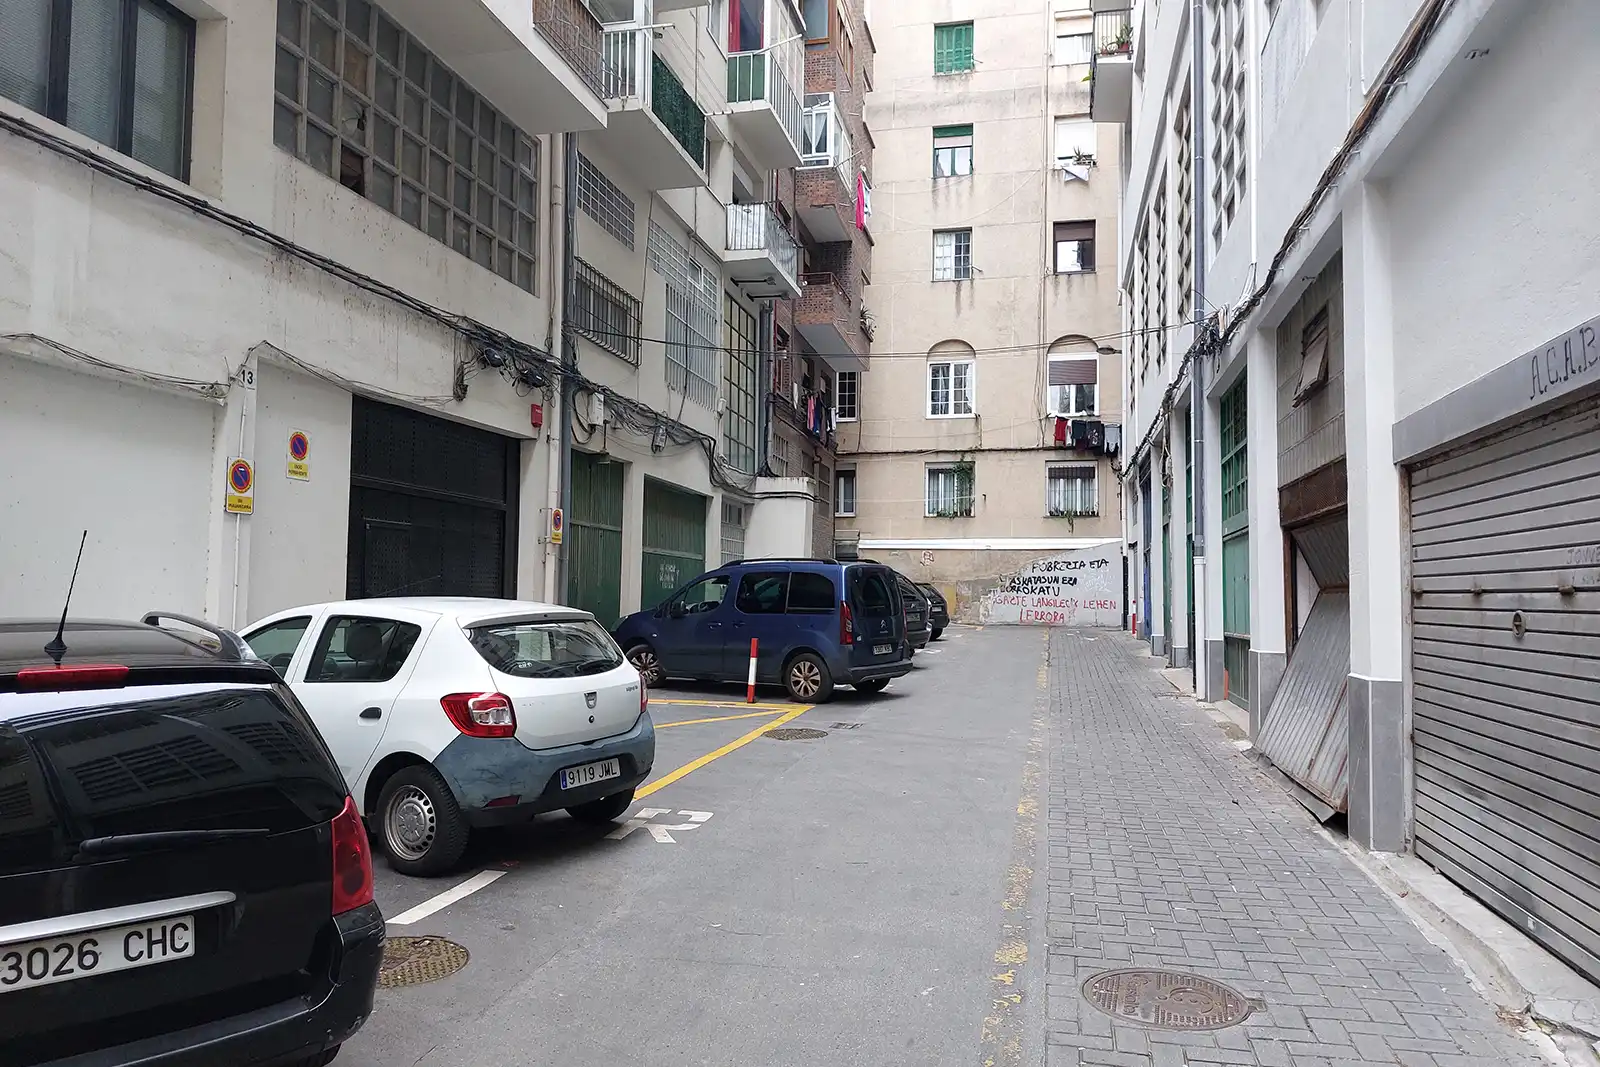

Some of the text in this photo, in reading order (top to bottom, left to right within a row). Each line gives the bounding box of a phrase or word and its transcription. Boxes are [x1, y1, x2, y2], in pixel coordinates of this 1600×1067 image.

[241, 370, 254, 385] 13
[1089, 558, 1109, 569] ETA
[1009, 576, 1060, 587] ASKATASUN
[1061, 576, 1078, 587] EZA
[1083, 599, 1117, 610] LEHEN
[568, 762, 618, 785] 9119 JML
[0, 922, 190, 985] 3026 CHC
